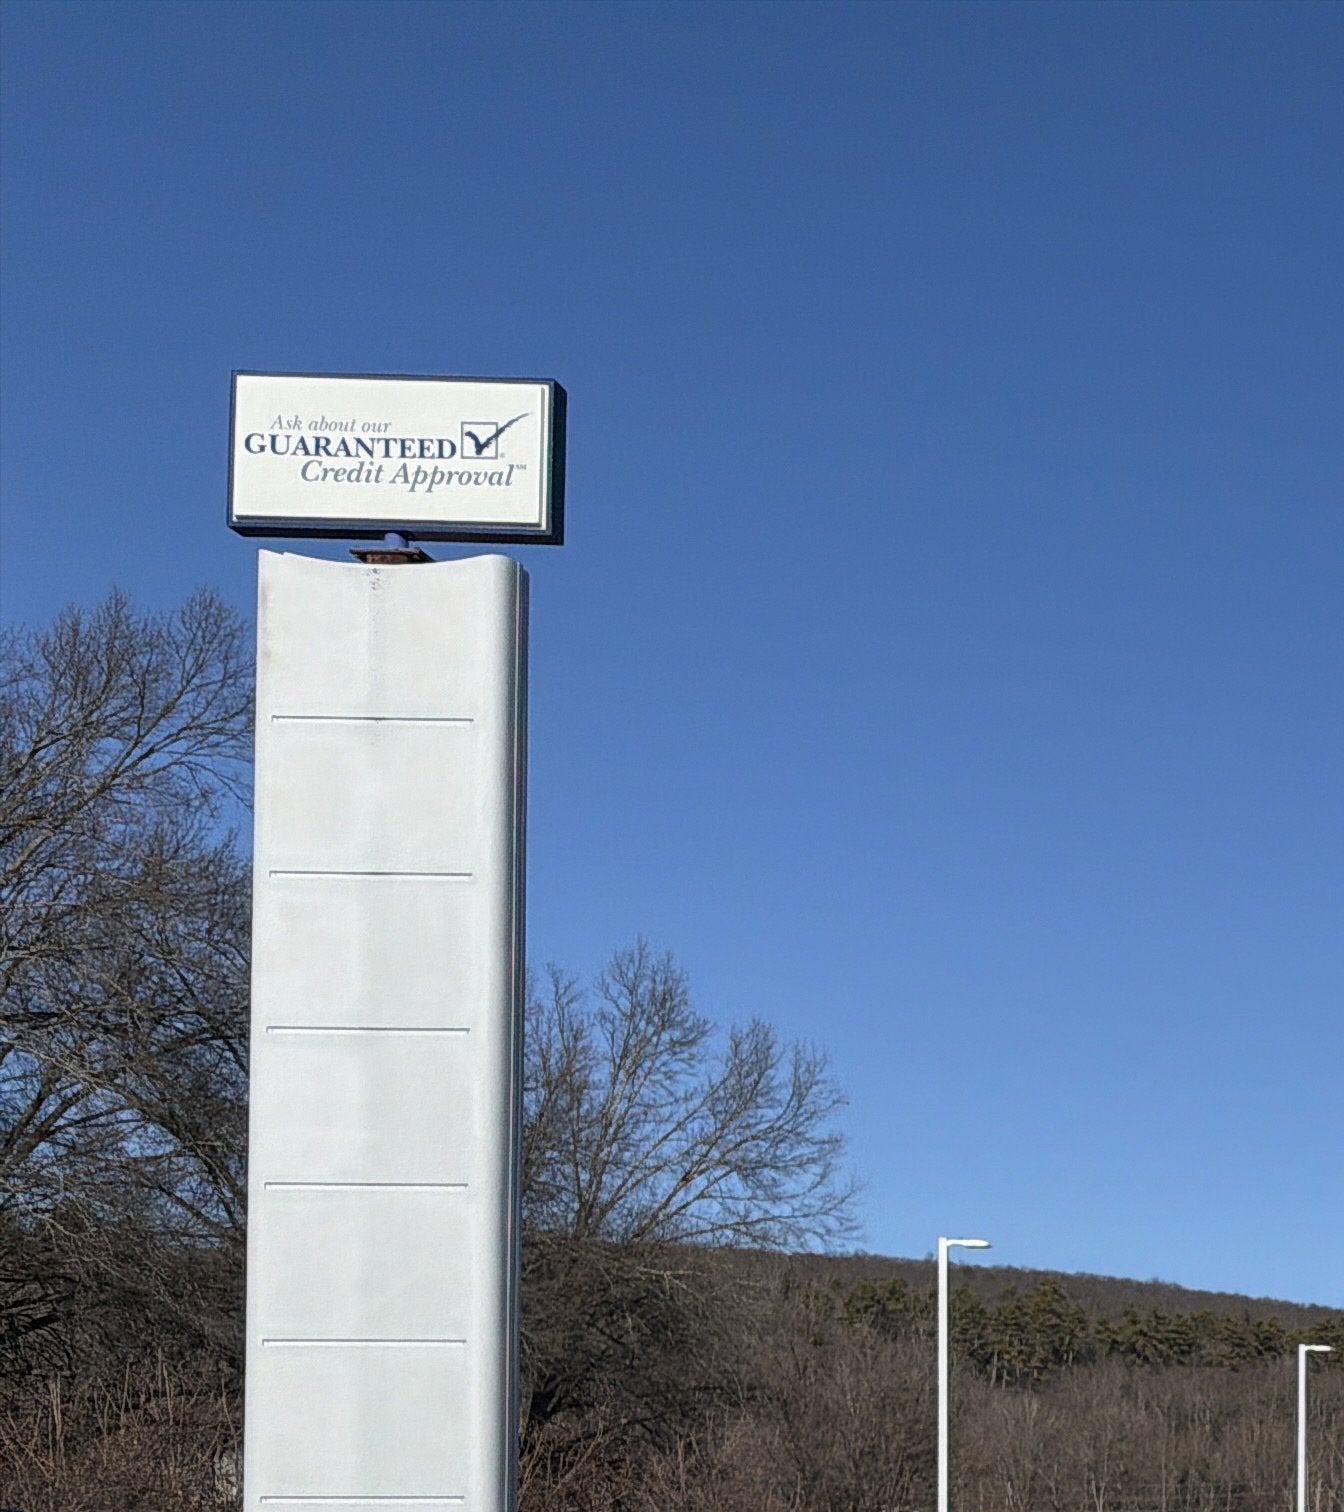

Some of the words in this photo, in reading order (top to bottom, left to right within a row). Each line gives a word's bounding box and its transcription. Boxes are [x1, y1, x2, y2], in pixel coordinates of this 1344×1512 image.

[270, 414, 302, 431] Ask
[308, 416, 357, 433] about
[361, 419, 392, 434] our
[244, 432, 457, 460] GUARANTEED
[300, 460, 384, 483] Credit
[389, 464, 514, 492] Approval
